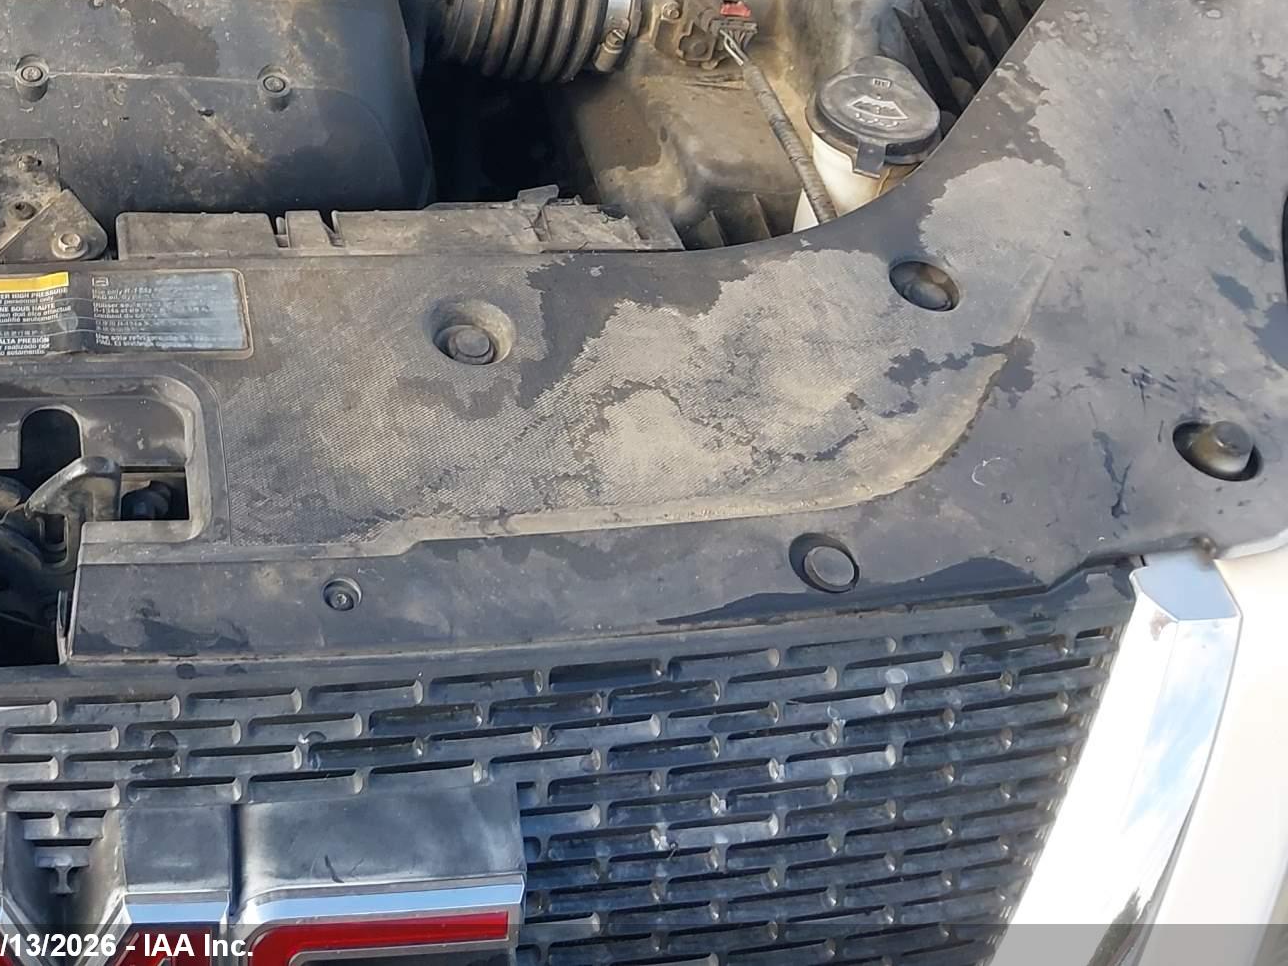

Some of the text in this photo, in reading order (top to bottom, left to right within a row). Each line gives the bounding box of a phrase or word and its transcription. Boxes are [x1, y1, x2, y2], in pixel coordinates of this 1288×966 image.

[4, 296, 38, 306] personnel
[11, 305, 30, 313] SOUS
[32, 302, 55, 312] HAUTE
